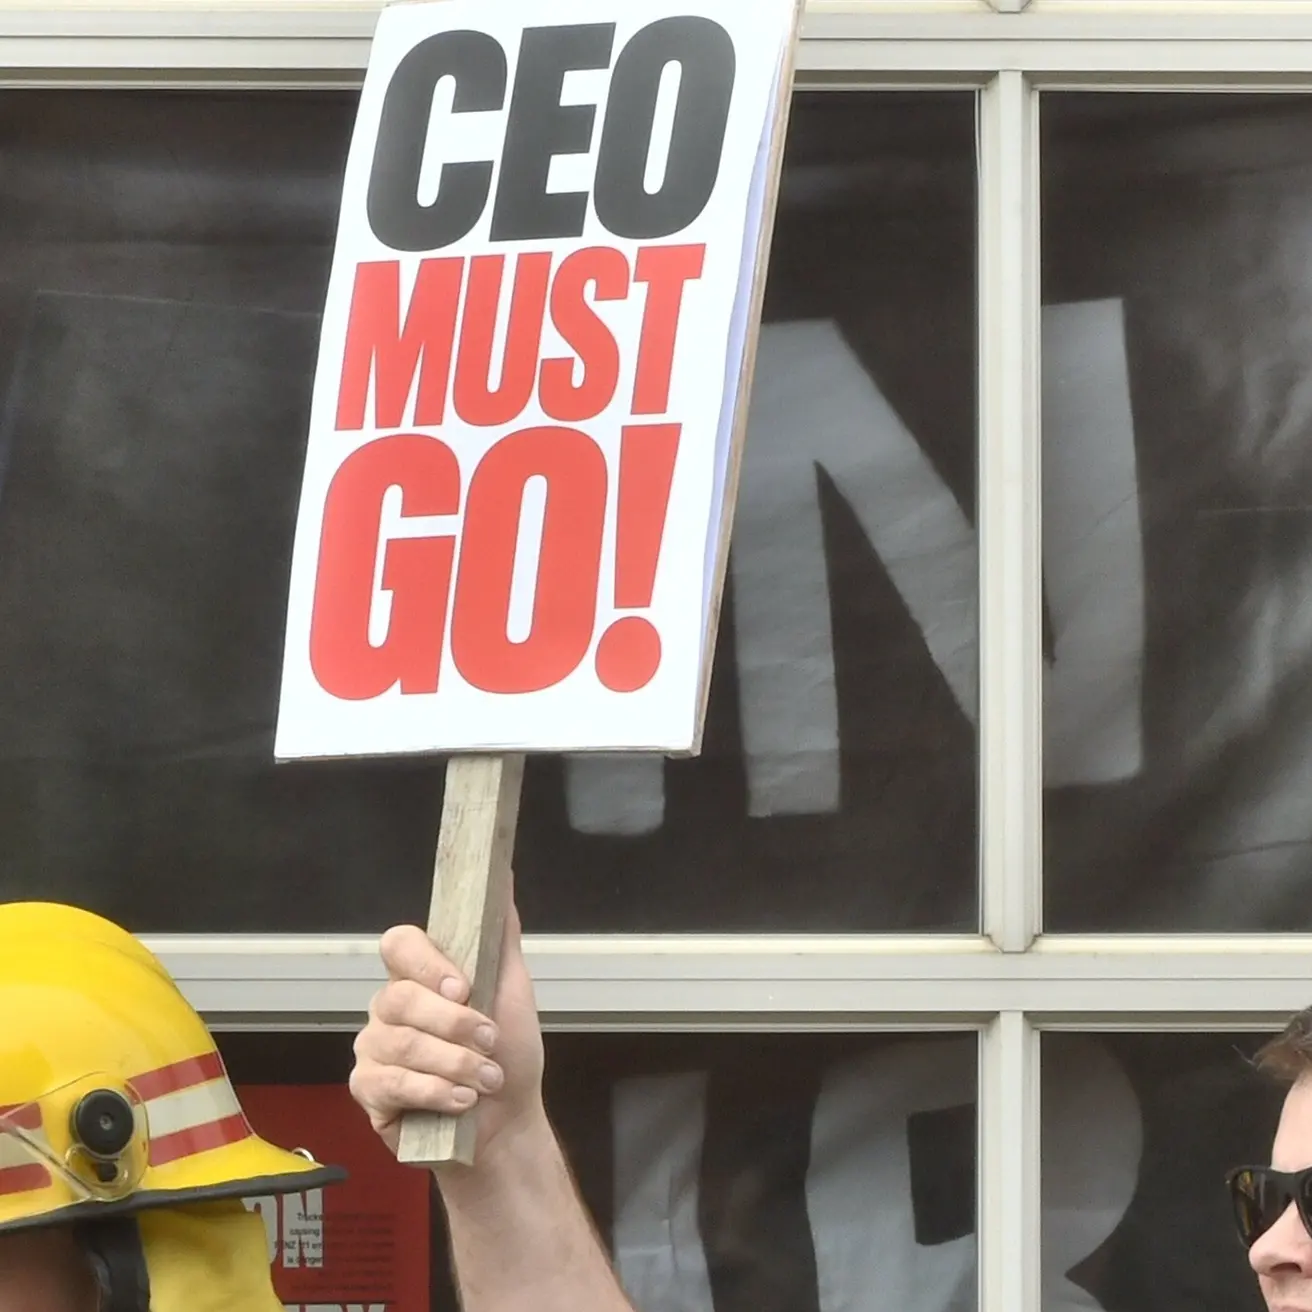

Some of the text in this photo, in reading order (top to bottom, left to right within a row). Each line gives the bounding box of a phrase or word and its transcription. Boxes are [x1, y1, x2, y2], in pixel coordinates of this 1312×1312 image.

[367, 15, 736, 251] CEO
[335, 243, 706, 431] MUST
[309, 423, 683, 700] GO!
